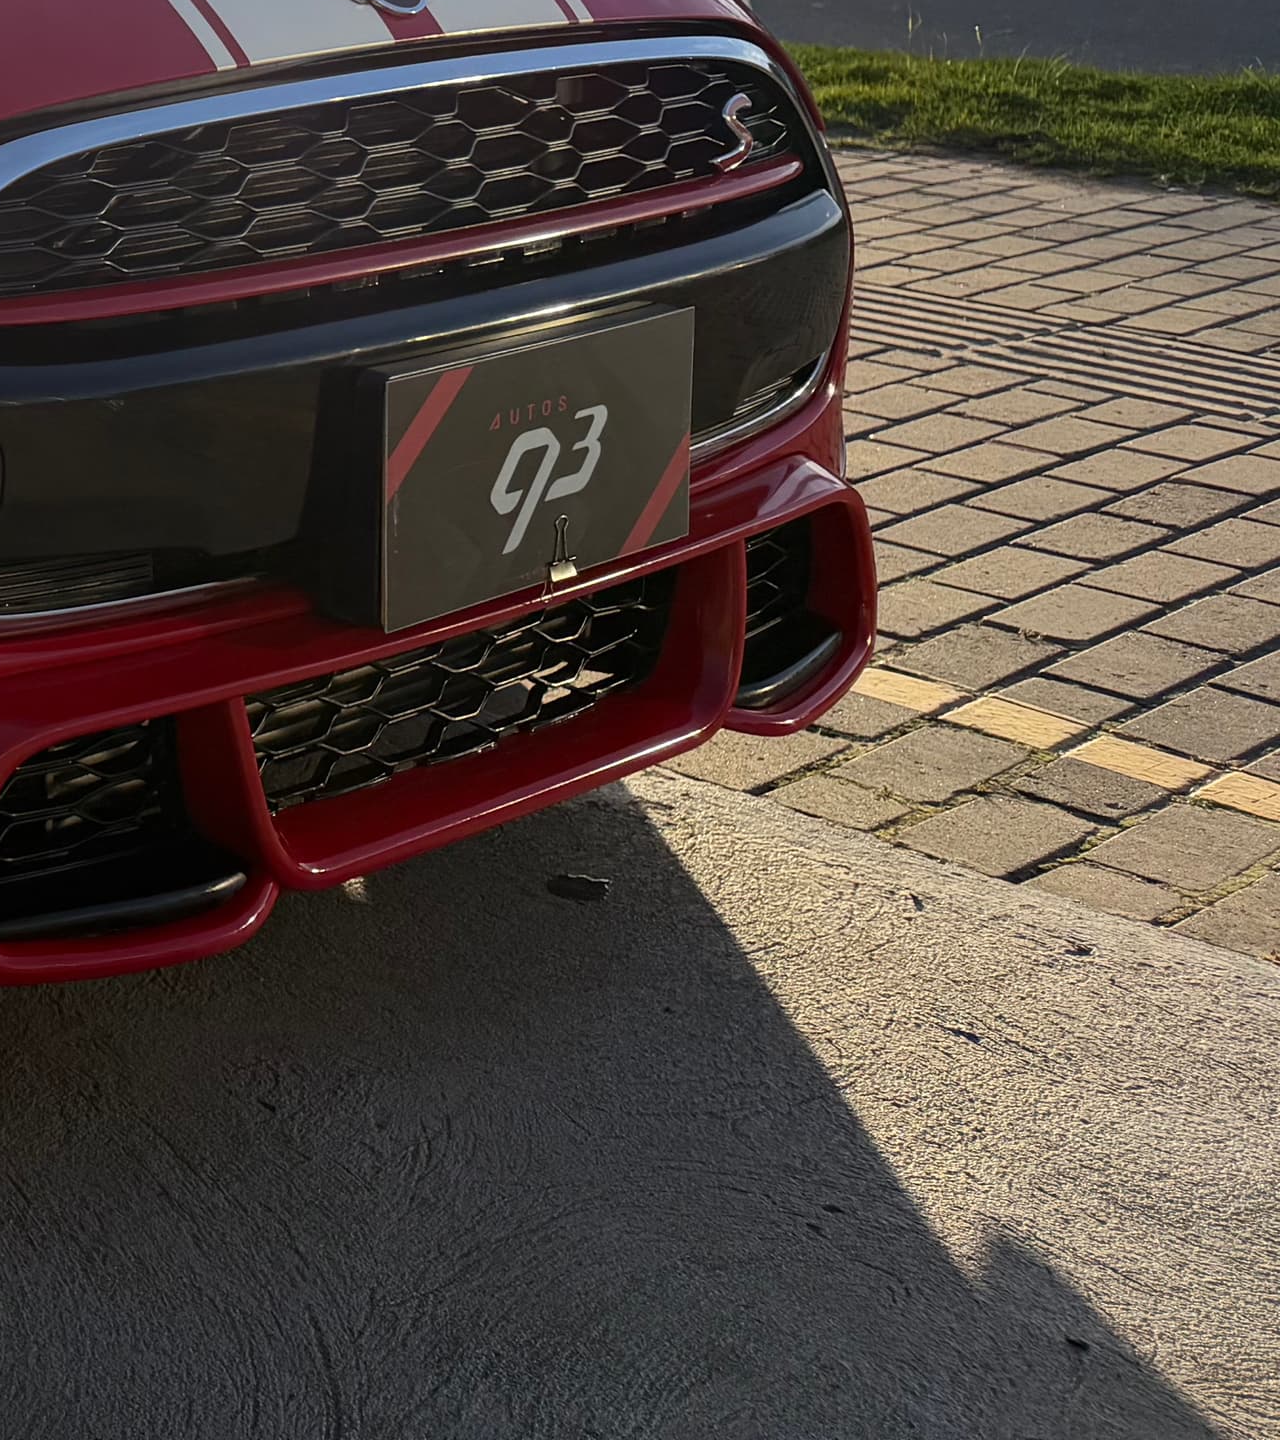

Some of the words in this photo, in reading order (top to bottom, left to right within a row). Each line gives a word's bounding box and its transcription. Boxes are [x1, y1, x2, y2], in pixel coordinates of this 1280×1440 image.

[709, 93, 753, 173] S
[489, 395, 569, 431] AUTOS
[490, 404, 609, 555] 93
